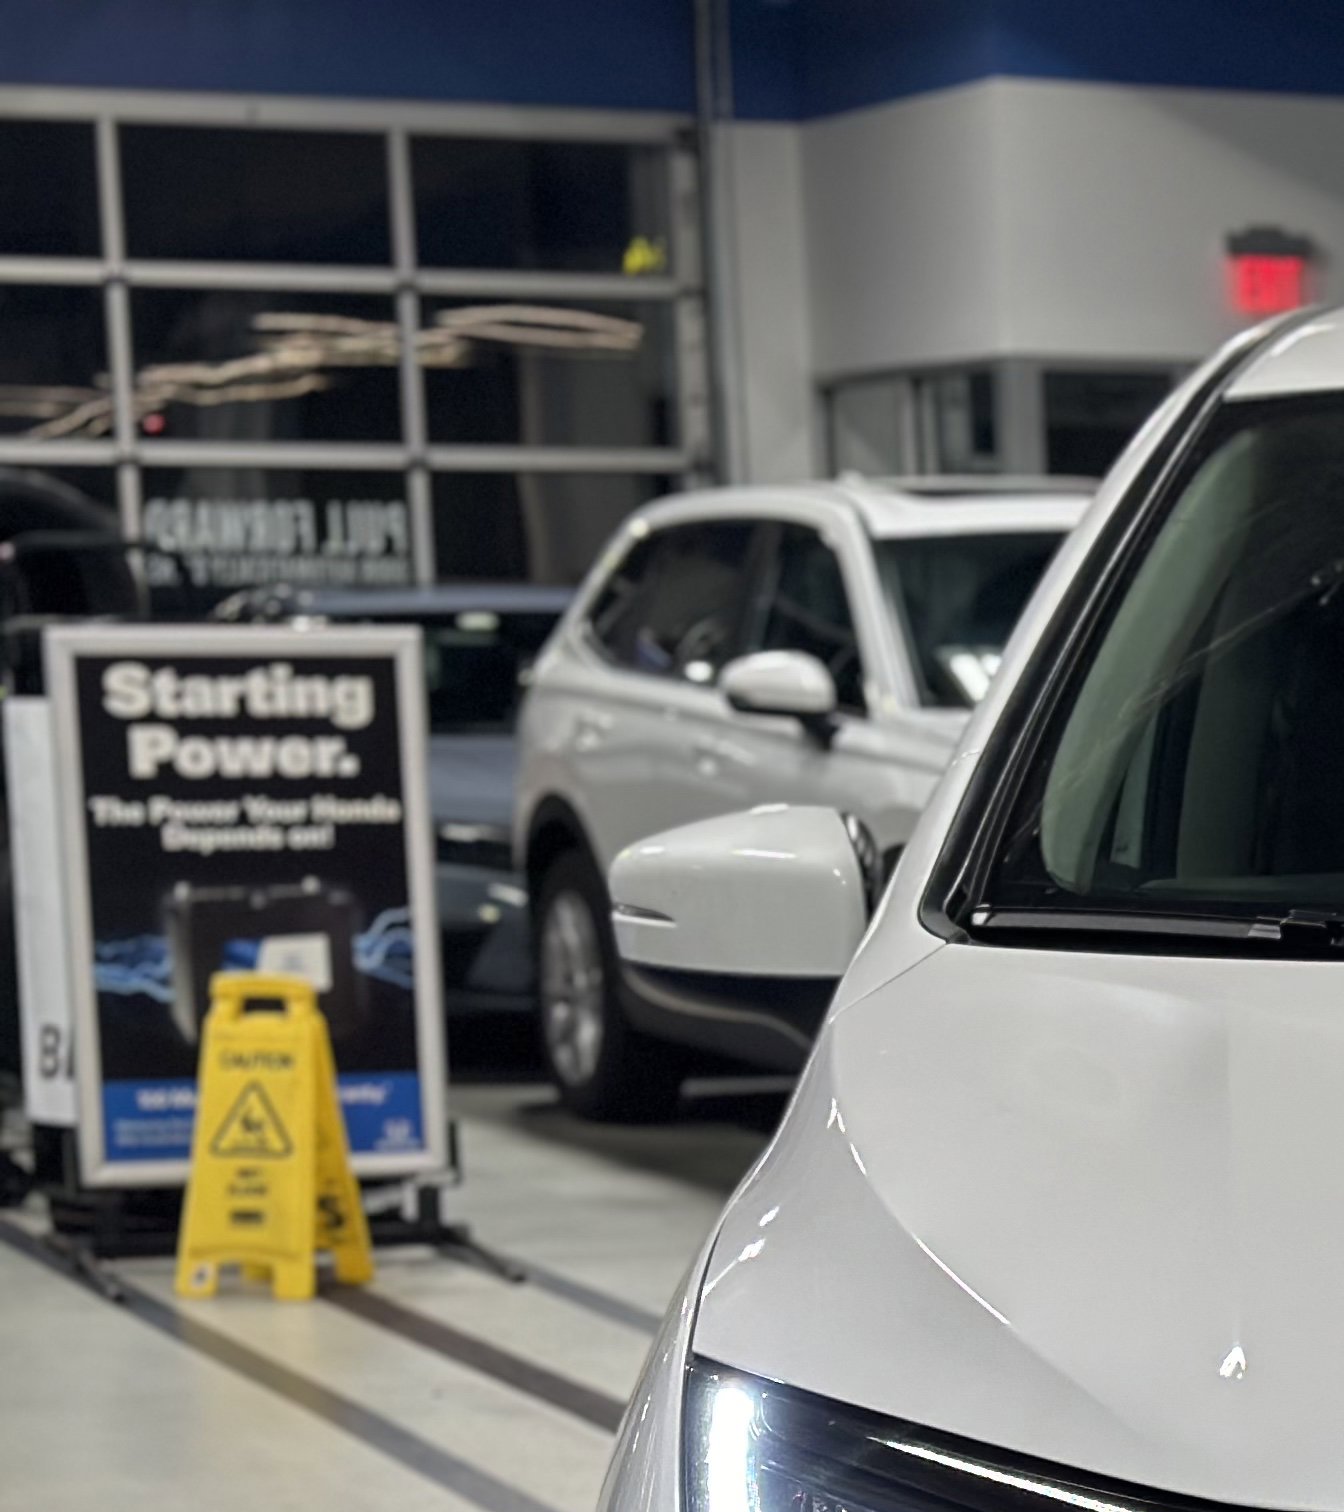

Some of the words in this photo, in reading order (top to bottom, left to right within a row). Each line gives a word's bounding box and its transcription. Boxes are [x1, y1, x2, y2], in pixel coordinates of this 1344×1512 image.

[102, 661, 375, 730] Starting
[126, 722, 361, 779] Power.
[89, 795, 146, 826] The
[148, 794, 240, 826] Power
[242, 794, 308, 824] Your
[310, 793, 402, 824] Honda
[161, 823, 286, 855] Depends
[218, 1051, 295, 1072] CAUTION
